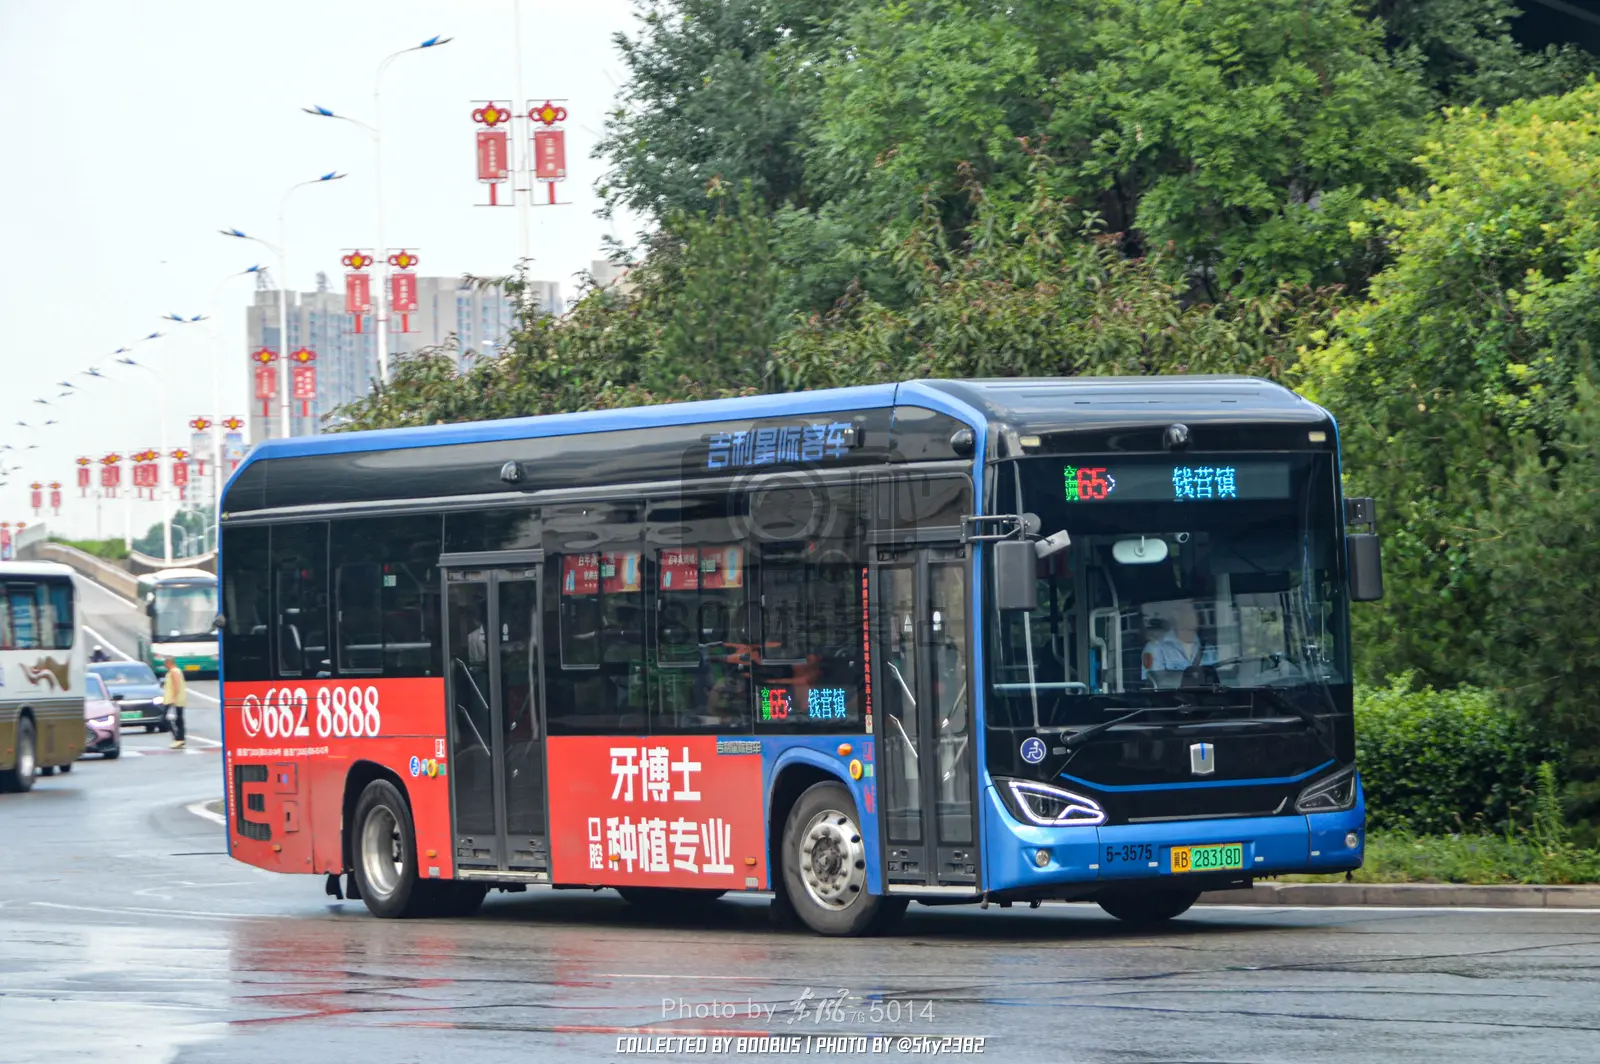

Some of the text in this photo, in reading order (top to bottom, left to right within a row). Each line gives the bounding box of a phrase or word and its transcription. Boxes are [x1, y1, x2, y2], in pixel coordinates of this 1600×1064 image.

[707, 421, 852, 469] 吉利星际客车
[1077, 467, 1107, 499] 65
[1173, 466, 1236, 498] 钱营镇
[263, 686, 380, 738] 682 8888
[769, 689, 788, 719] 65
[808, 688, 846, 718] 钱营镇
[609, 746, 702, 802] 牙博士
[588, 816, 735, 874] 口腔 种植专业
[1106, 844, 1152, 862] 5-3575
